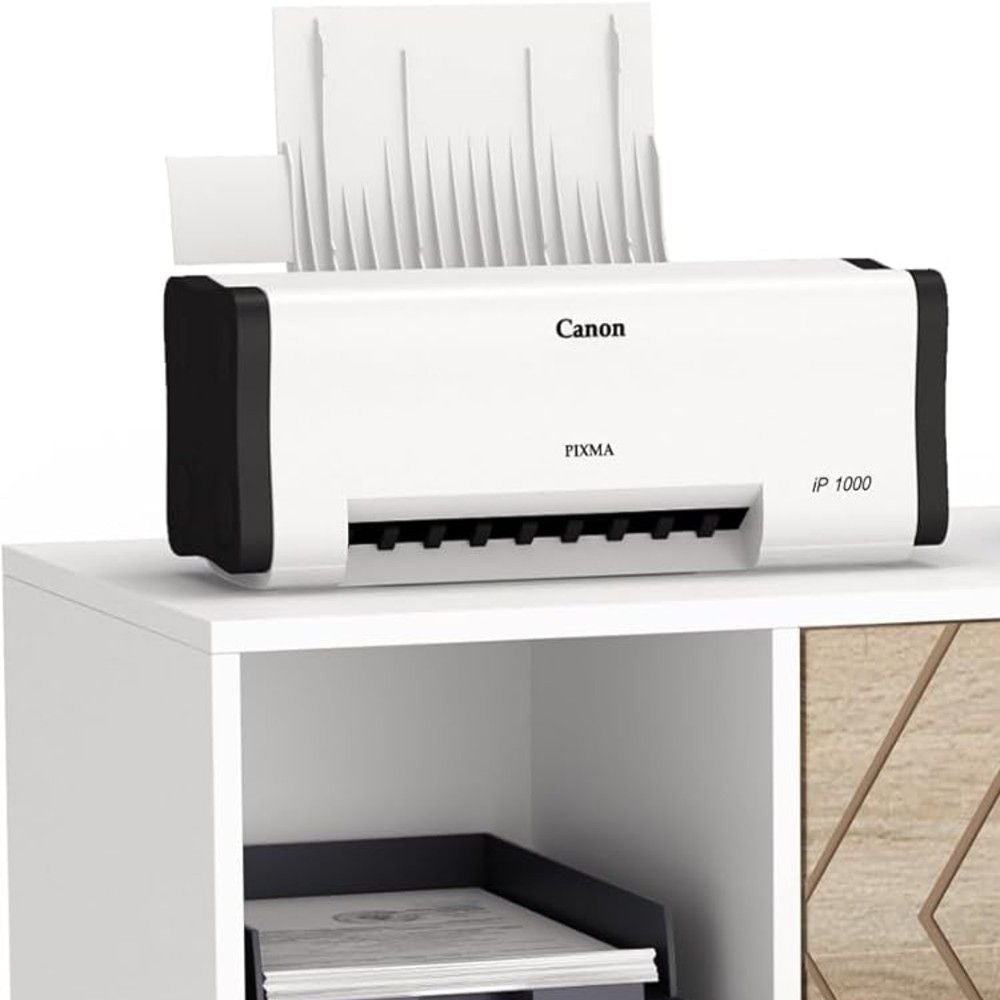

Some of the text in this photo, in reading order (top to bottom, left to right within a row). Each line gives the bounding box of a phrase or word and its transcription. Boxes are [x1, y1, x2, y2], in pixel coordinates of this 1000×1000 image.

[555, 318, 626, 338] Canon
[564, 443, 615, 457] PIXMA
[811, 475, 872, 493] iP 1000
